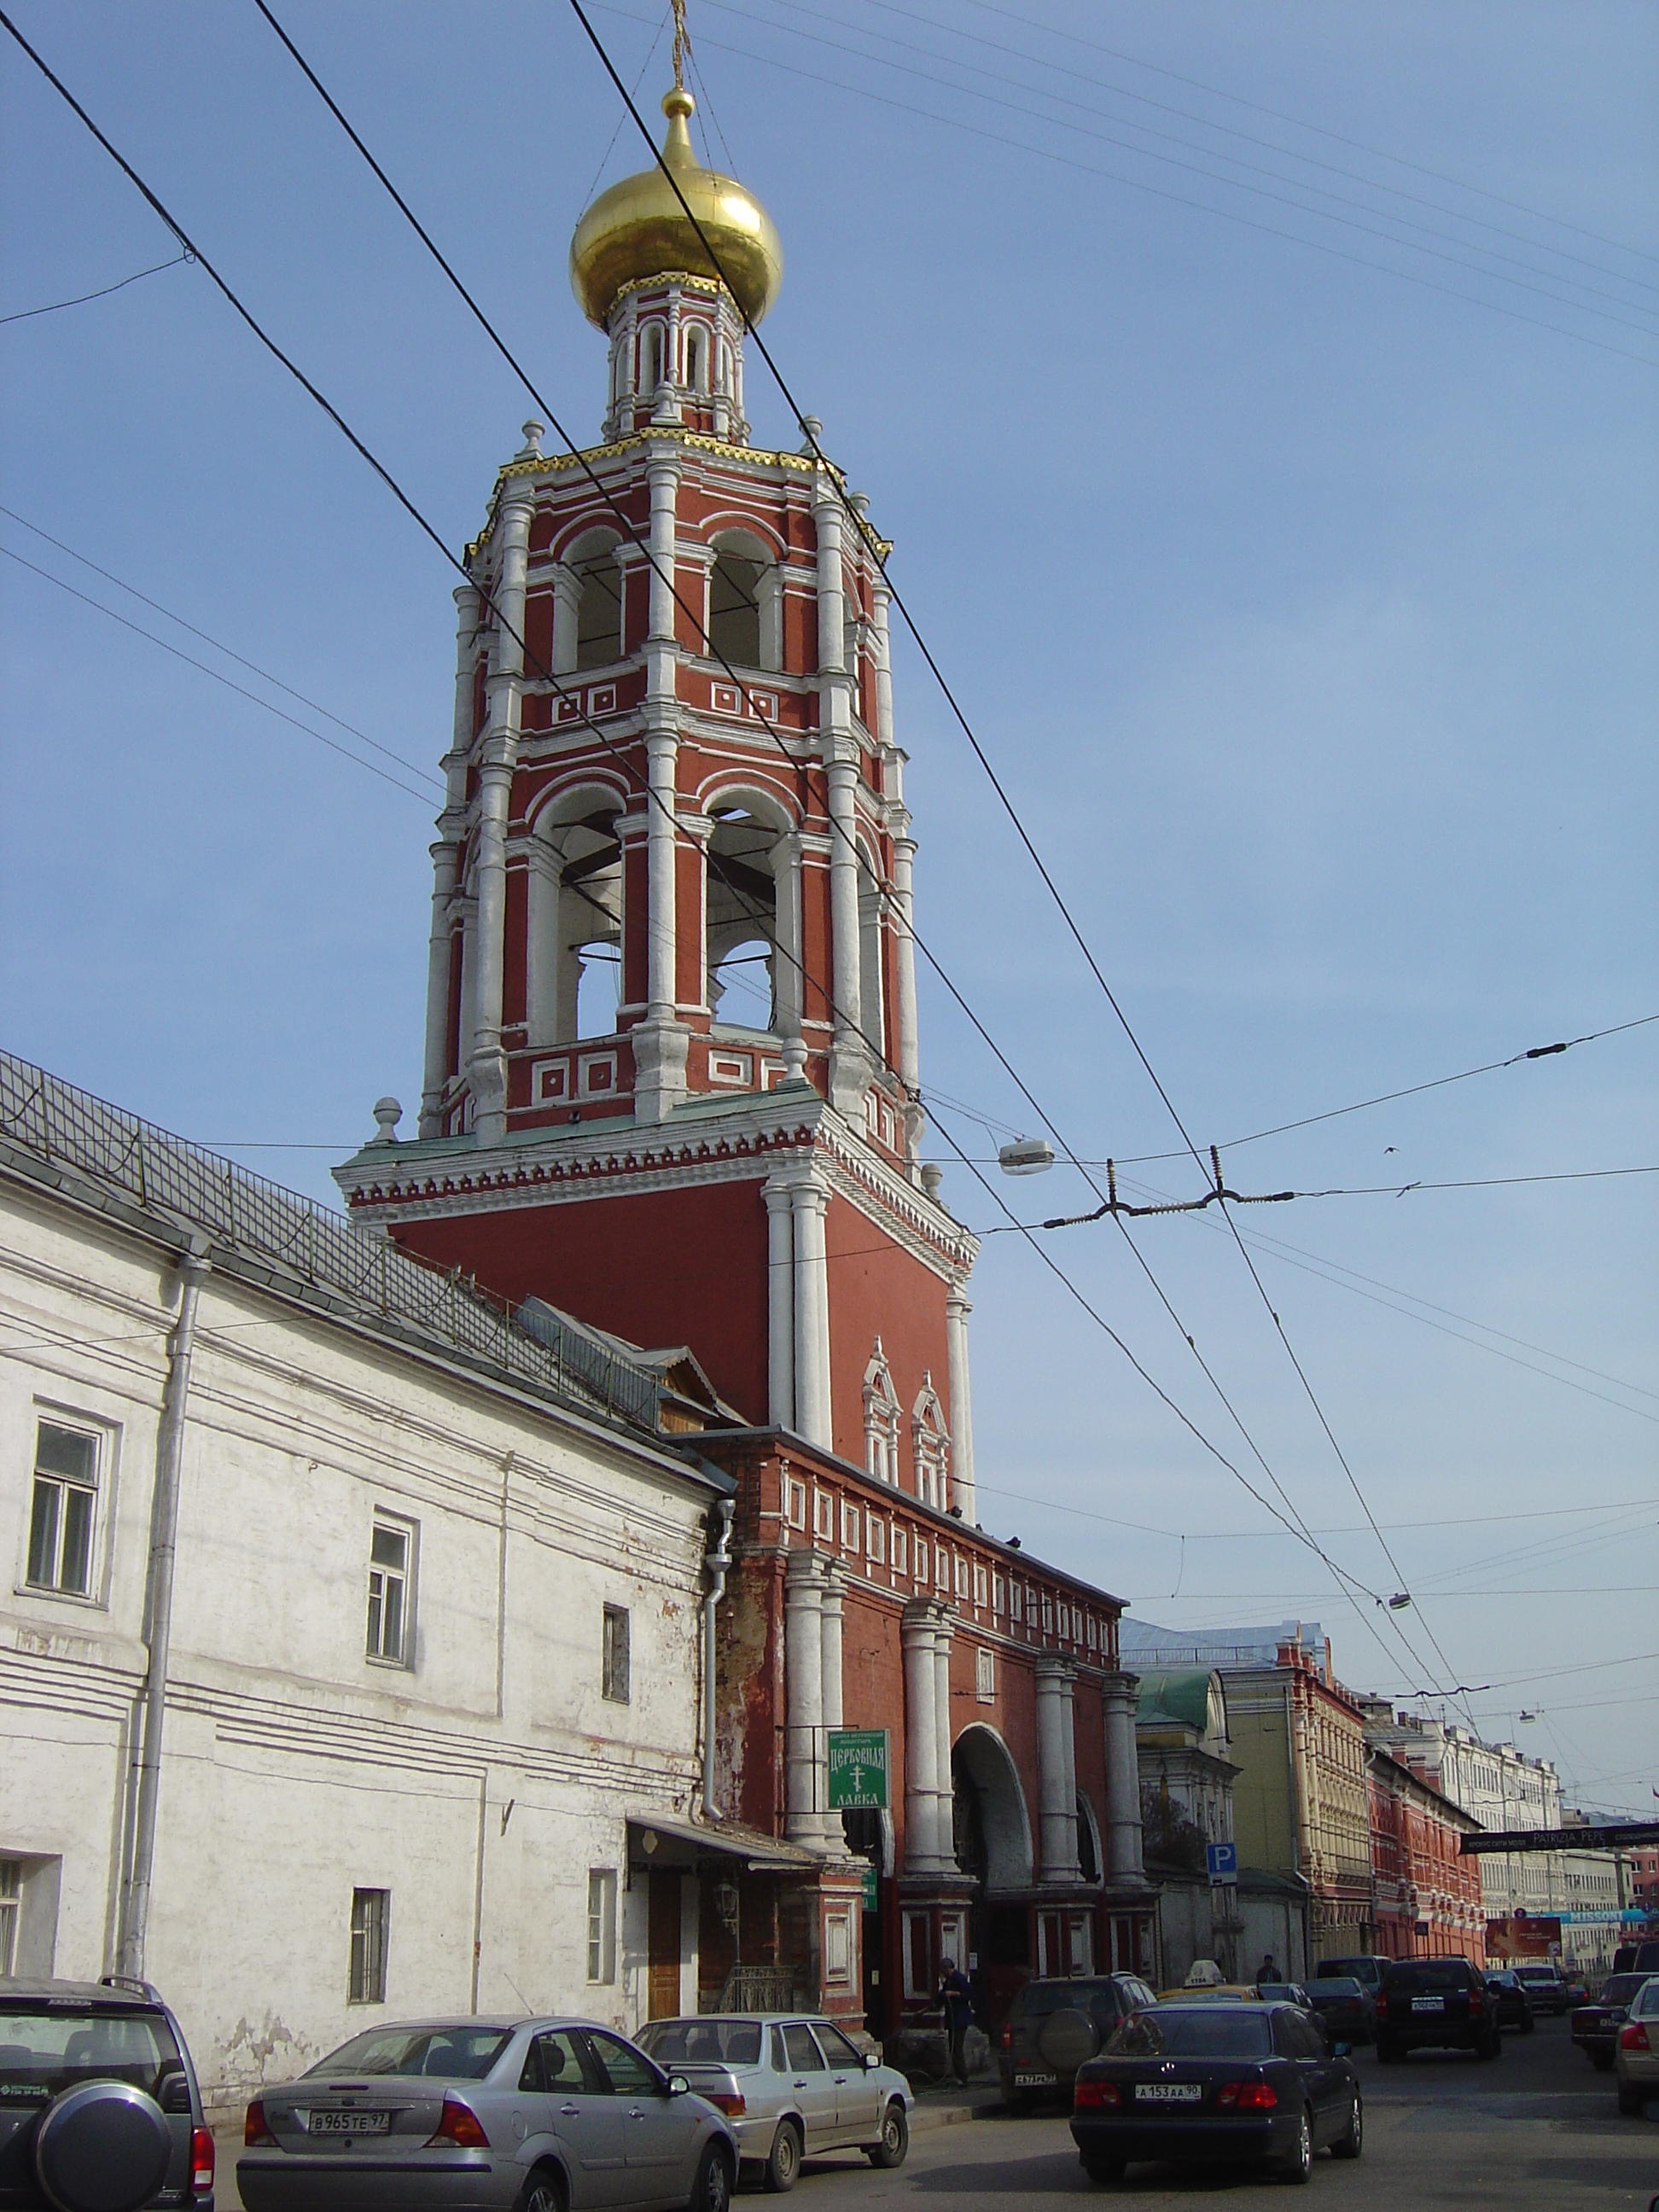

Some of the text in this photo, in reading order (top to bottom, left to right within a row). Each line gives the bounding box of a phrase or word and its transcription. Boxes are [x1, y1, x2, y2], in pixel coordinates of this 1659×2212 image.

[830, 1747, 884, 1773] ЦЕРКОВНАЯ
[837, 1793, 879, 1806] ЛАВКА
[1534, 1830, 1605, 1843] PATRIZIA PEPE
[1214, 1846, 1231, 1871] P
[1570, 1911, 1623, 1922] MISSONI
[1186, 2085, 1197, 2094] 90
[371, 2113, 384, 2125] 97
